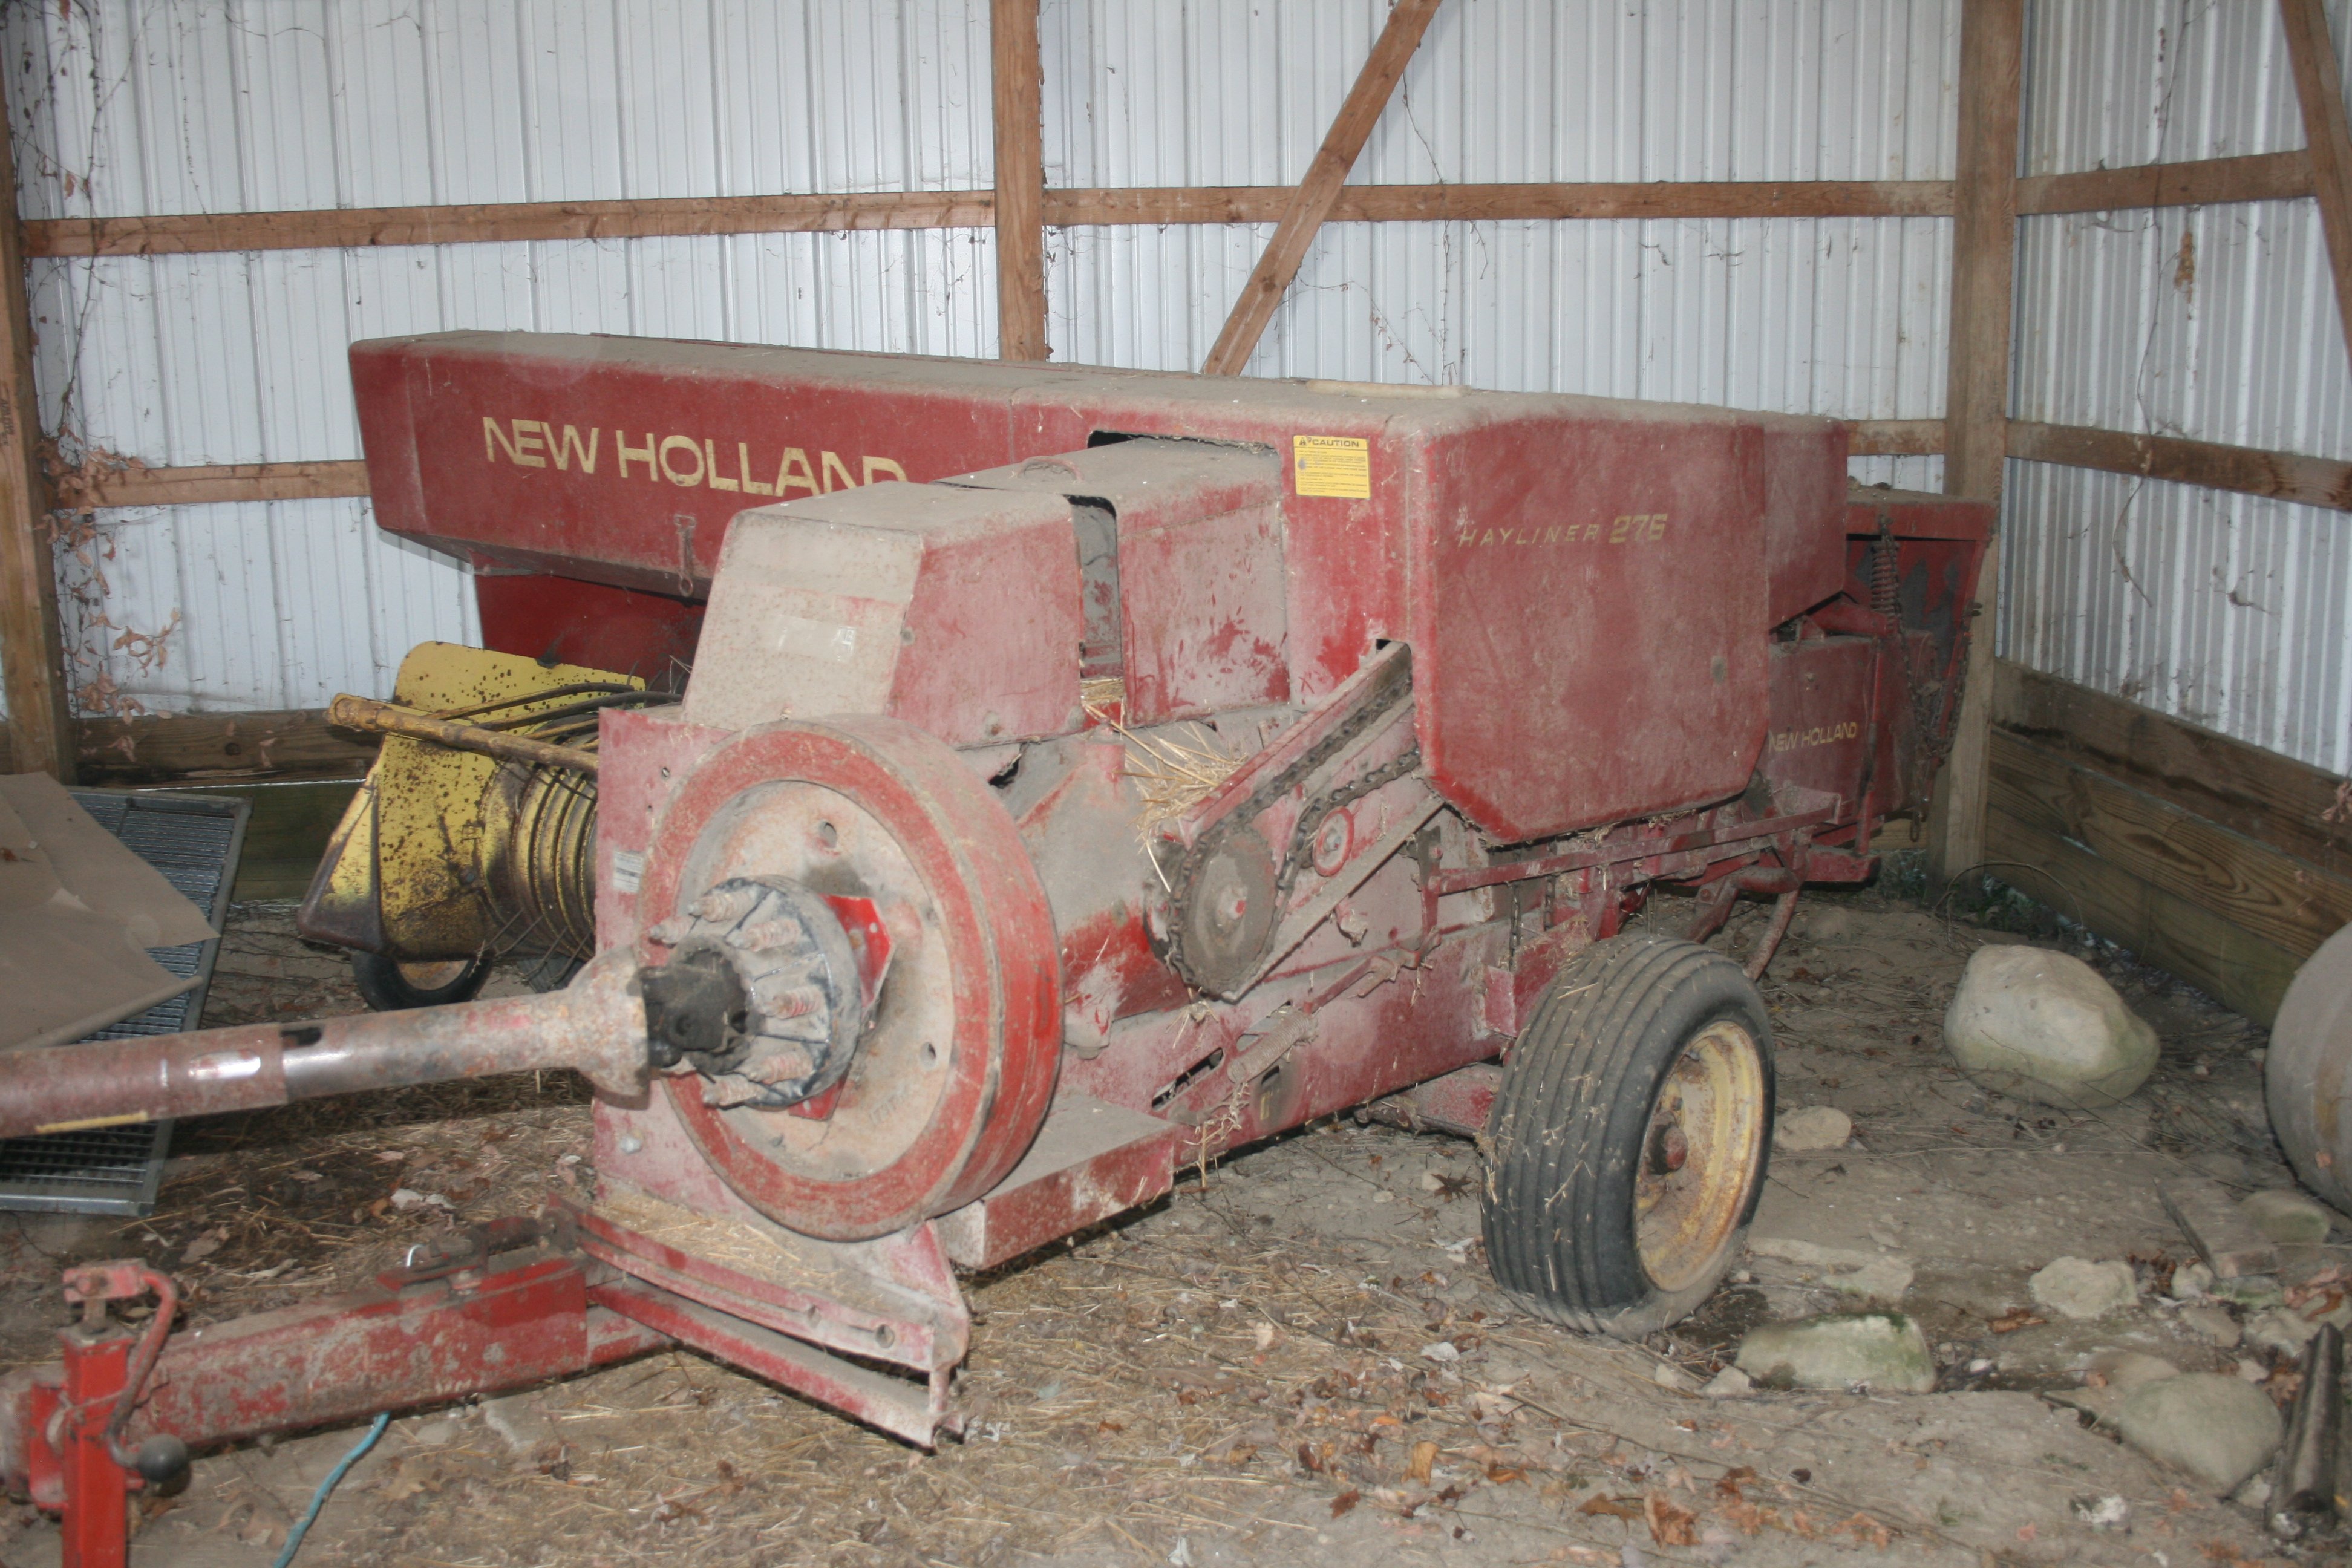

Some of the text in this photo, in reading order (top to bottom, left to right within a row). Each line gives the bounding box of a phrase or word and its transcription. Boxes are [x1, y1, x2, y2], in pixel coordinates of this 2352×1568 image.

[482, 417, 907, 497] NEW HOLLAND
[1312, 439, 1359, 448] CAUTION
[1458, 514, 1668, 548] HAYLINER 276
[1768, 722, 1858, 753] NEW HOLLAND
